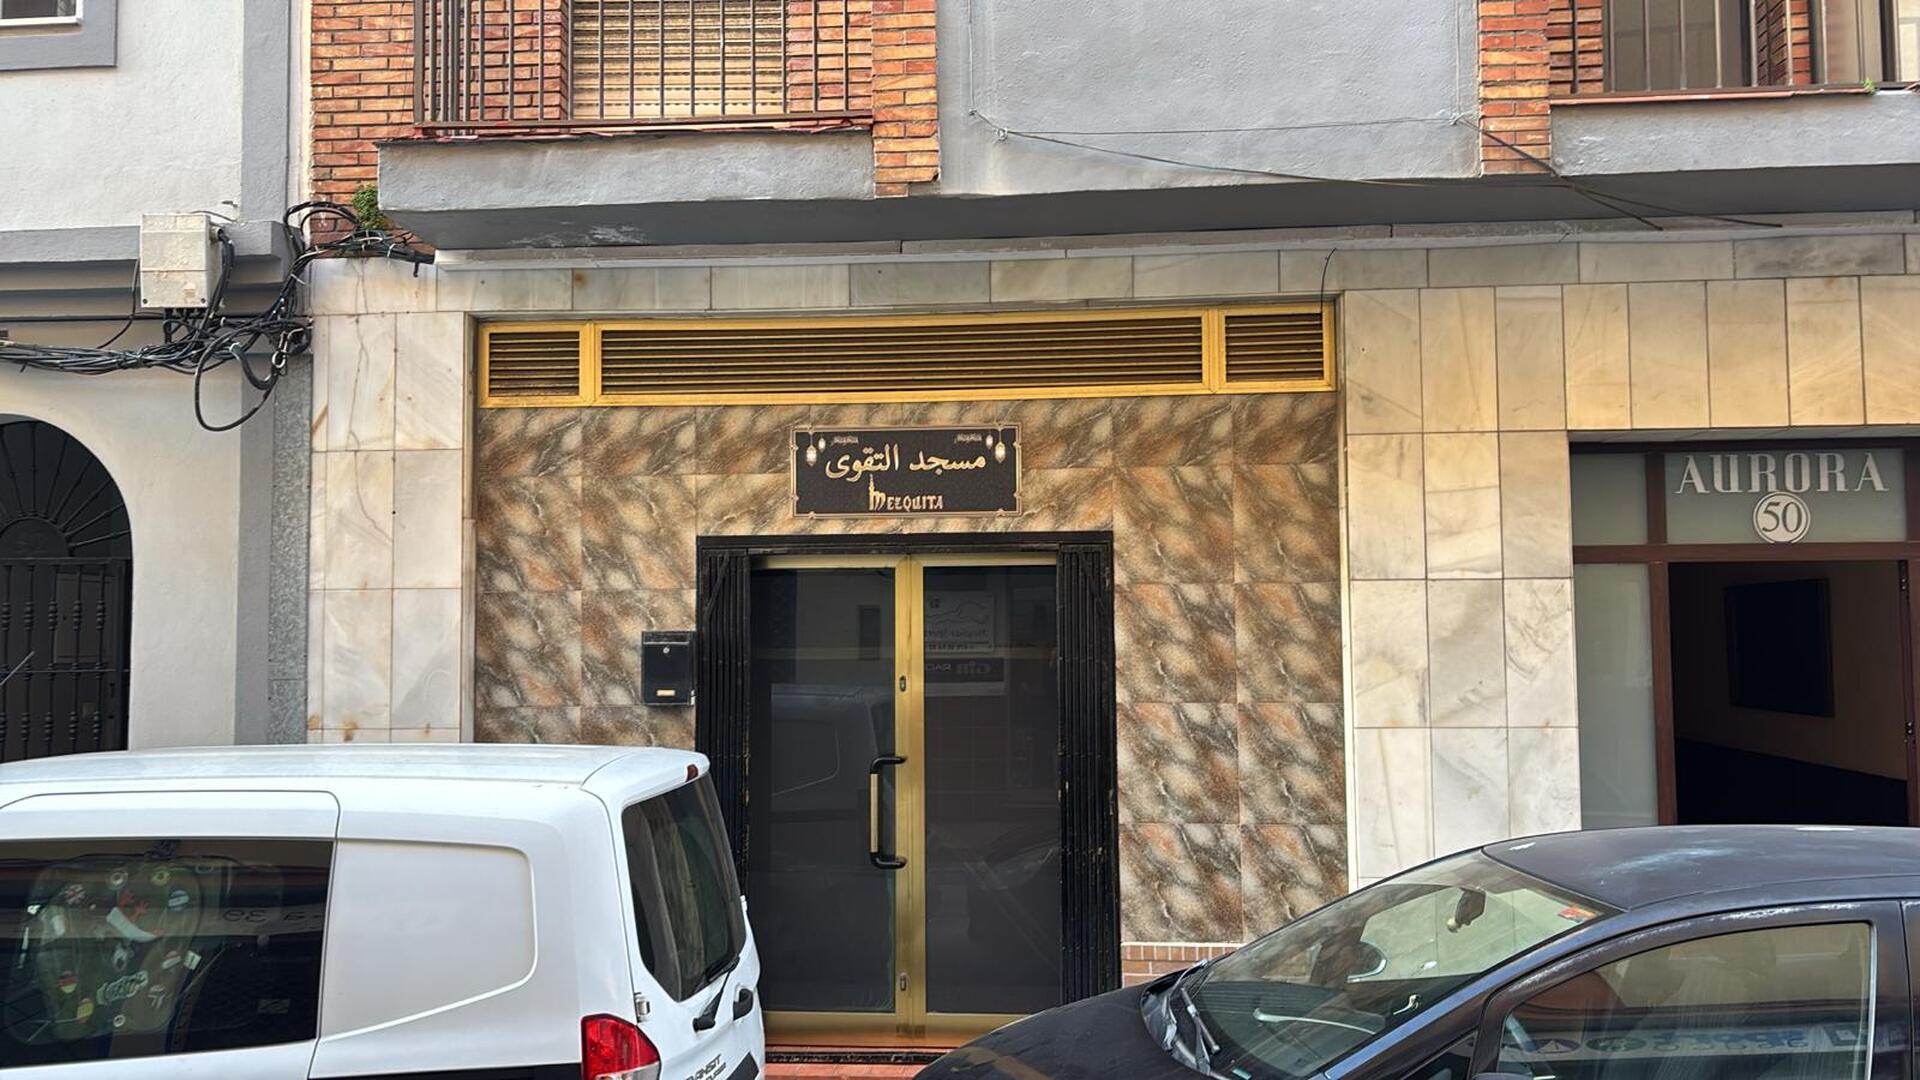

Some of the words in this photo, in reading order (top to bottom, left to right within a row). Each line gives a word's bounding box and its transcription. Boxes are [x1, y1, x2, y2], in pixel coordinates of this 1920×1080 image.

[825, 443, 899, 482] التقوى
[909, 450, 986, 476] مسجد
[1675, 452, 1889, 494] AURORA
[868, 476, 943, 511] MEZQUITA
[1762, 501, 1801, 533] 50
